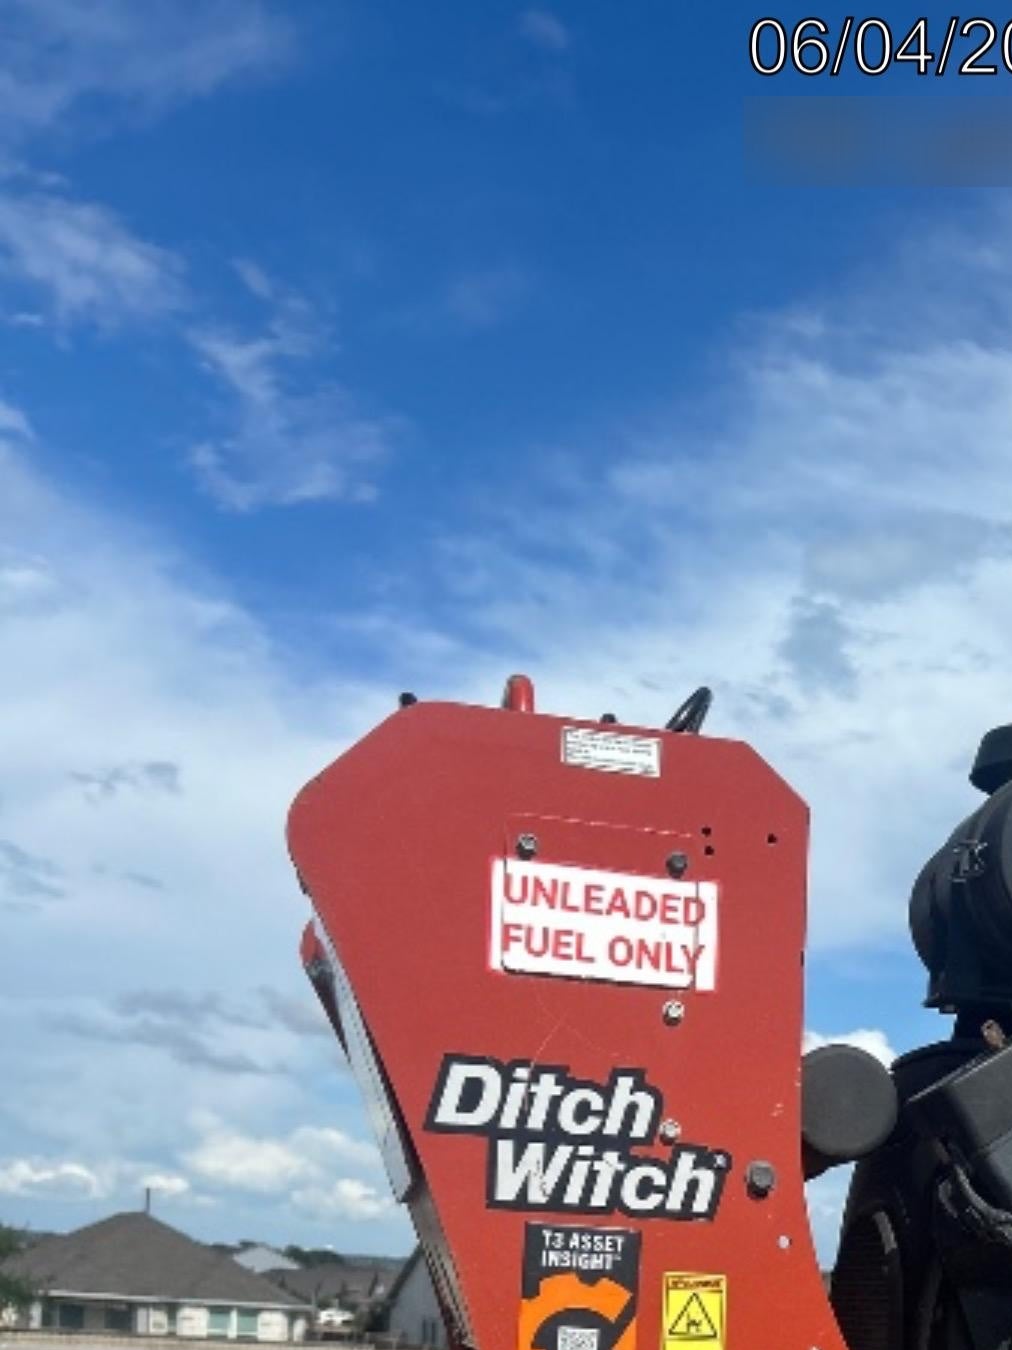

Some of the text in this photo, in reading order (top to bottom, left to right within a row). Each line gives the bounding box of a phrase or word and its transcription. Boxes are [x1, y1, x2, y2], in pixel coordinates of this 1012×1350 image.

[503, 873, 706, 927] UNLEADED
[502, 923, 706, 973] FUEL ONLY
[434, 1063, 655, 1138] Ditch
[542, 1229, 625, 1252] T3 ASSET
